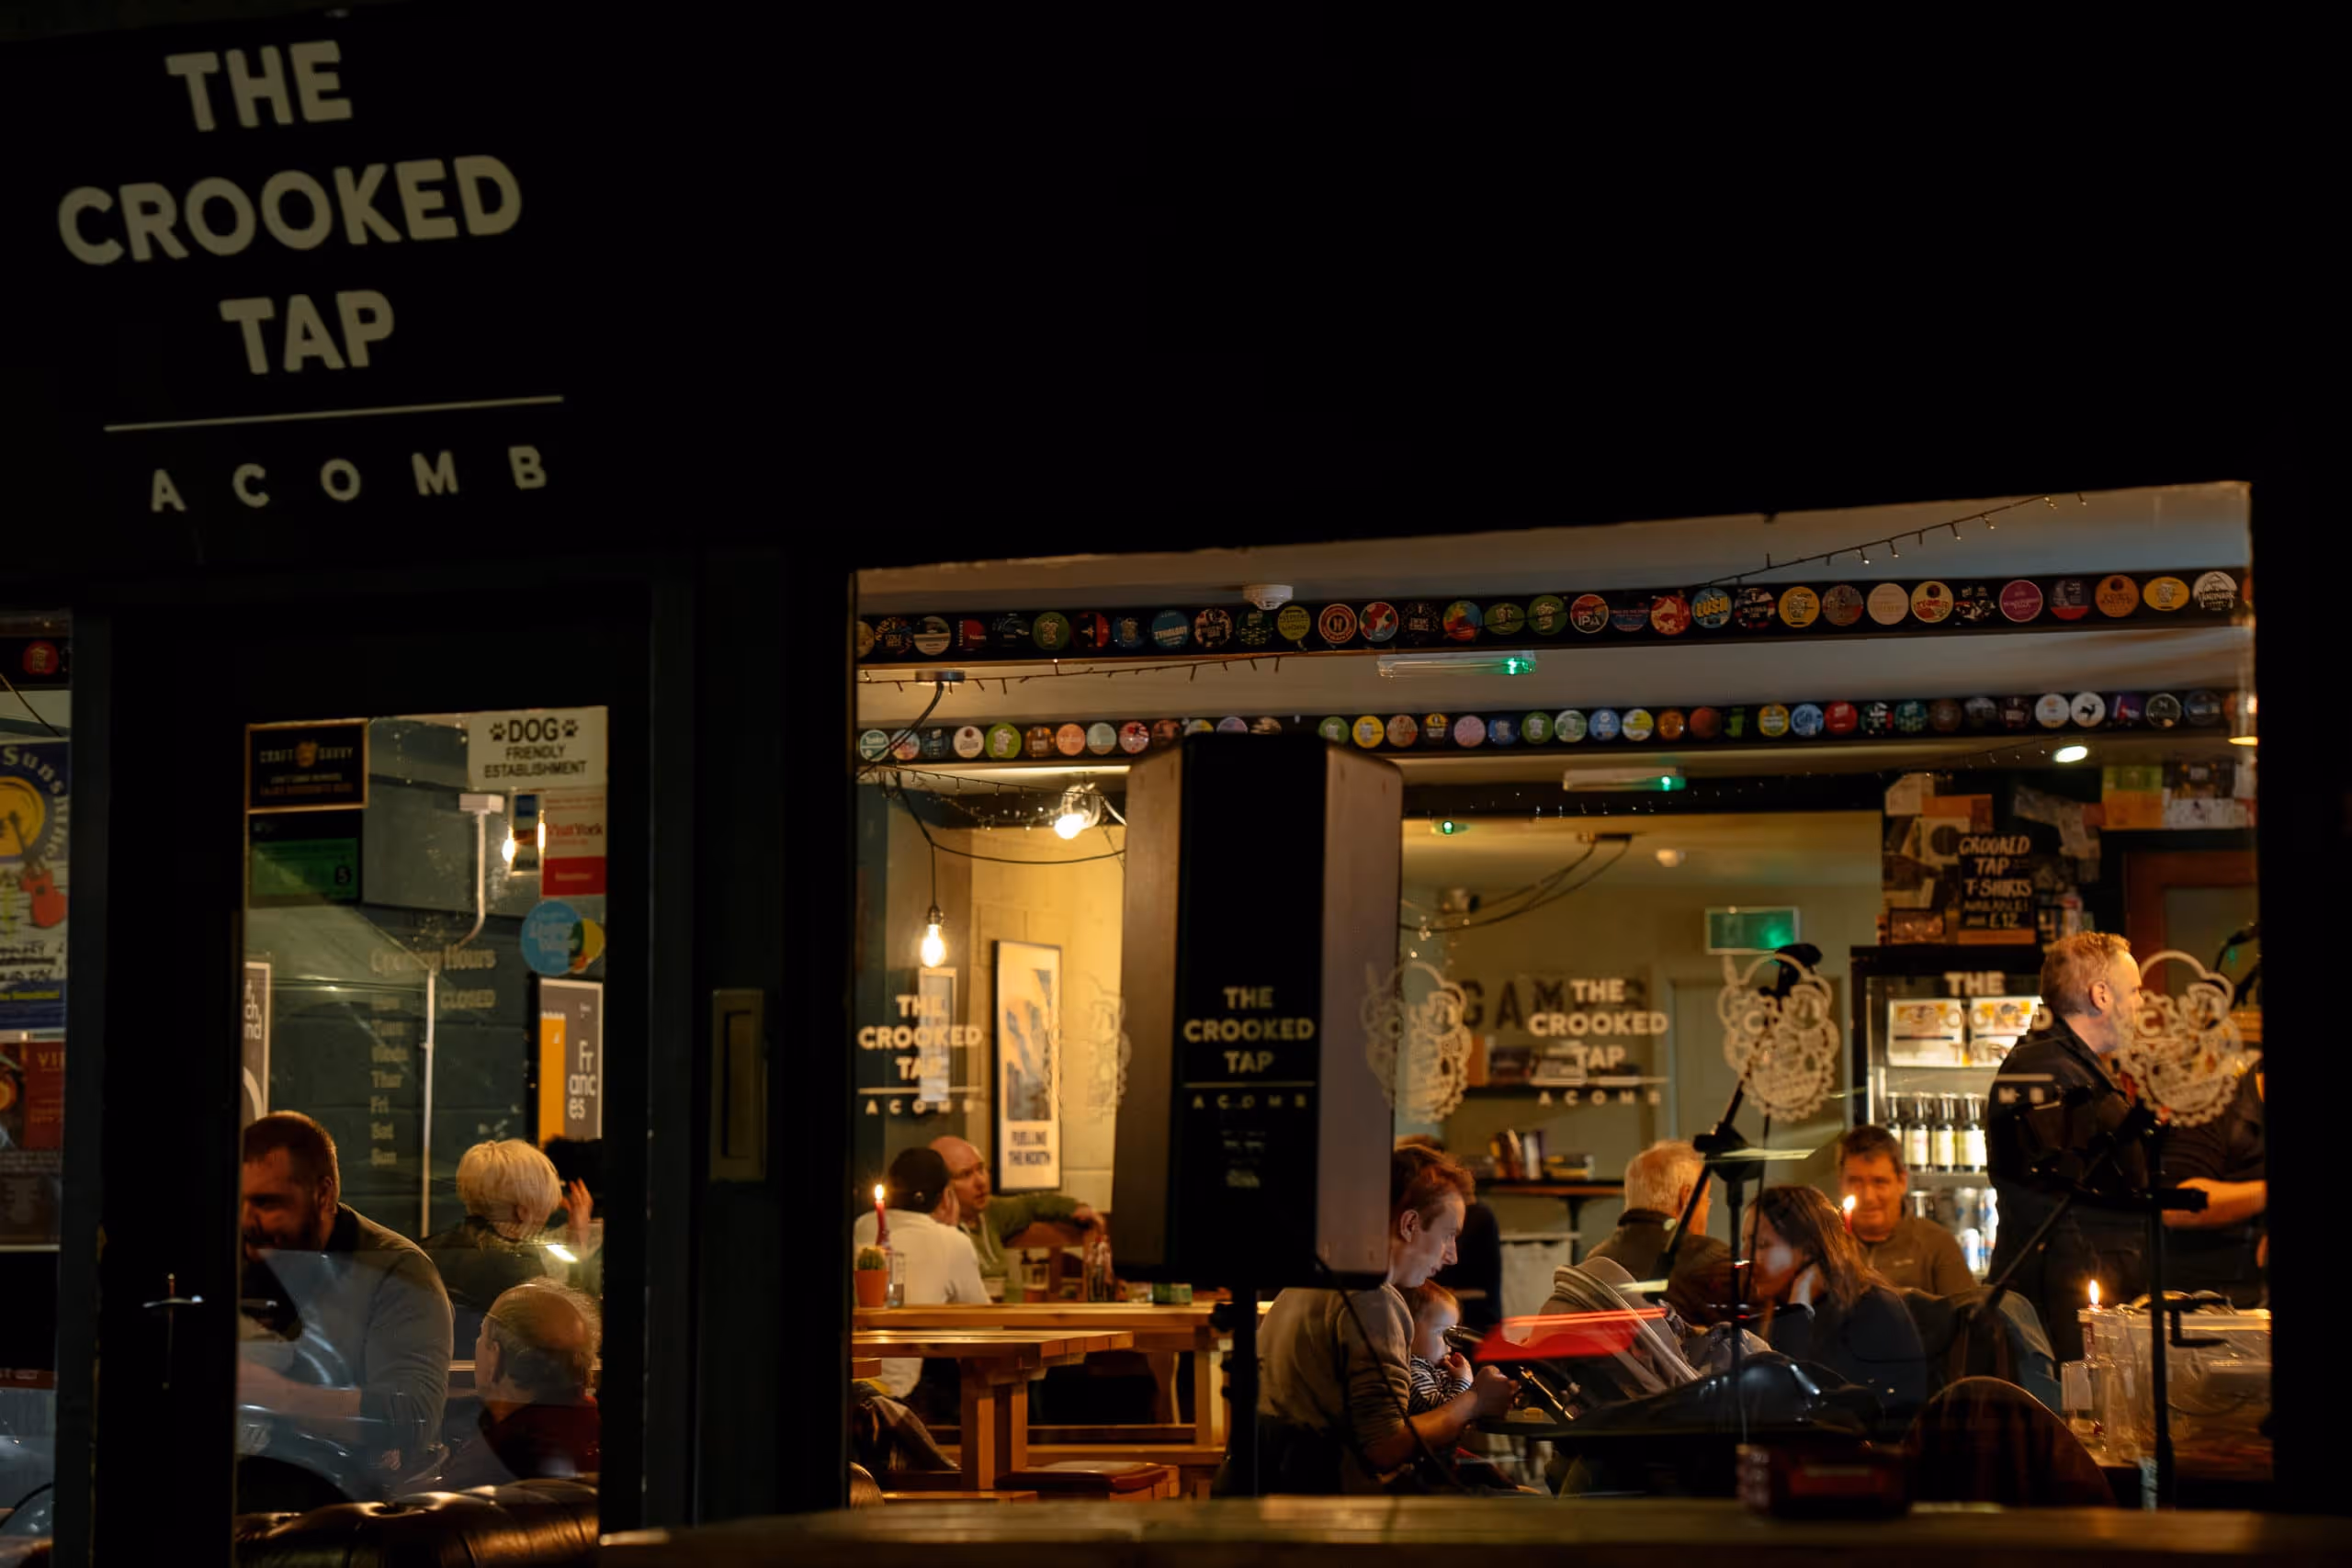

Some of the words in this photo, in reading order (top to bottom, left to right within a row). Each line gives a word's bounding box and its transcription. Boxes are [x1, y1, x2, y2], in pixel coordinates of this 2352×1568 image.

[164, 39, 355, 132] THE
[56, 153, 524, 266] CROOKED
[219, 288, 396, 375] TAP
[149, 443, 550, 514] ACOMB
[509, 717, 559, 742] DOG
[506, 746, 565, 761] FRIENDLY
[484, 761, 587, 779] ESTABLISHMENT
[1974, 856, 2011, 876] TAP
[1570, 978, 1625, 1003] THE
[1943, 970, 2007, 996] THE
[896, 994, 944, 1018] THE
[1222, 985, 1276, 1010] THE
[1182, 1016, 1317, 1043] CROOKED
[1528, 1010, 1669, 1037] CROOKED
[857, 1024, 983, 1050] CROOKED
[895, 1055, 942, 1080] TAP
[1222, 1050, 1274, 1074] TAP
[1574, 1045, 1626, 1069] TAP
